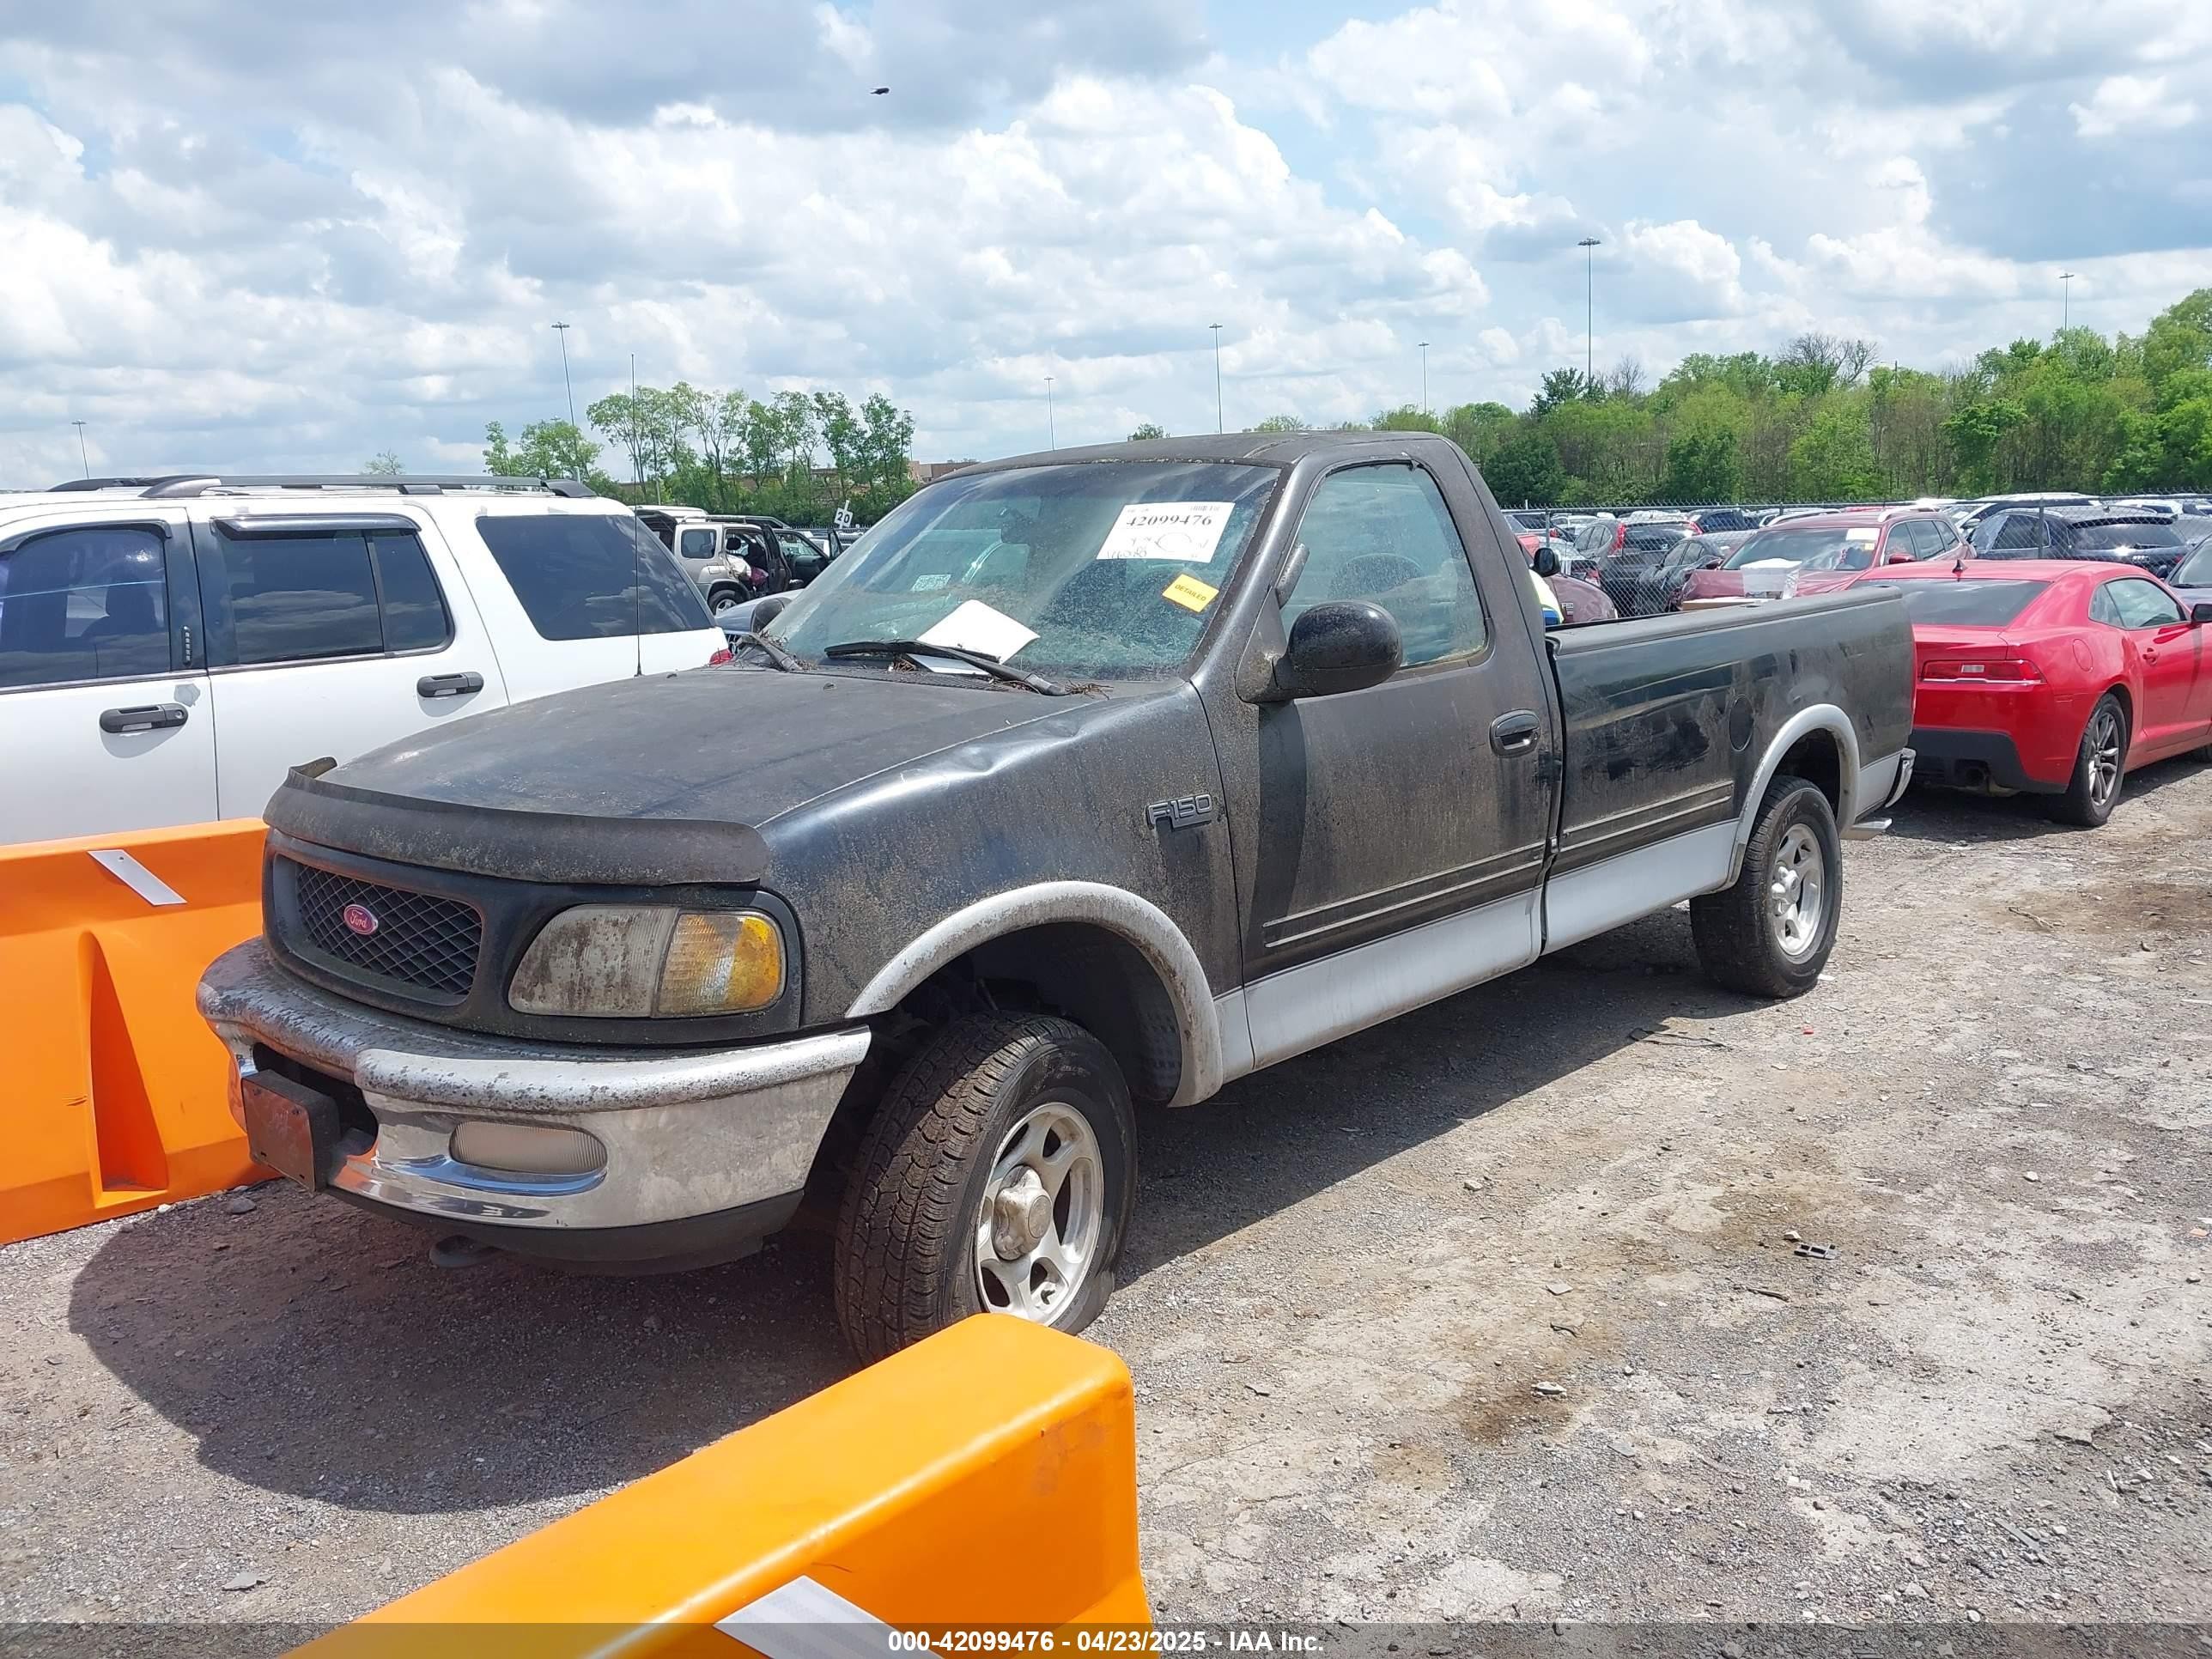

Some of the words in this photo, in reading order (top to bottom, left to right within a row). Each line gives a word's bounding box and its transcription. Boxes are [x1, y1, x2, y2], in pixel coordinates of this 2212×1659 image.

[837, 511, 850, 524] 20
[1127, 514, 1212, 526] 42099476
[1174, 584, 1206, 601] DETAILED
[349, 909, 368, 929] Ford
